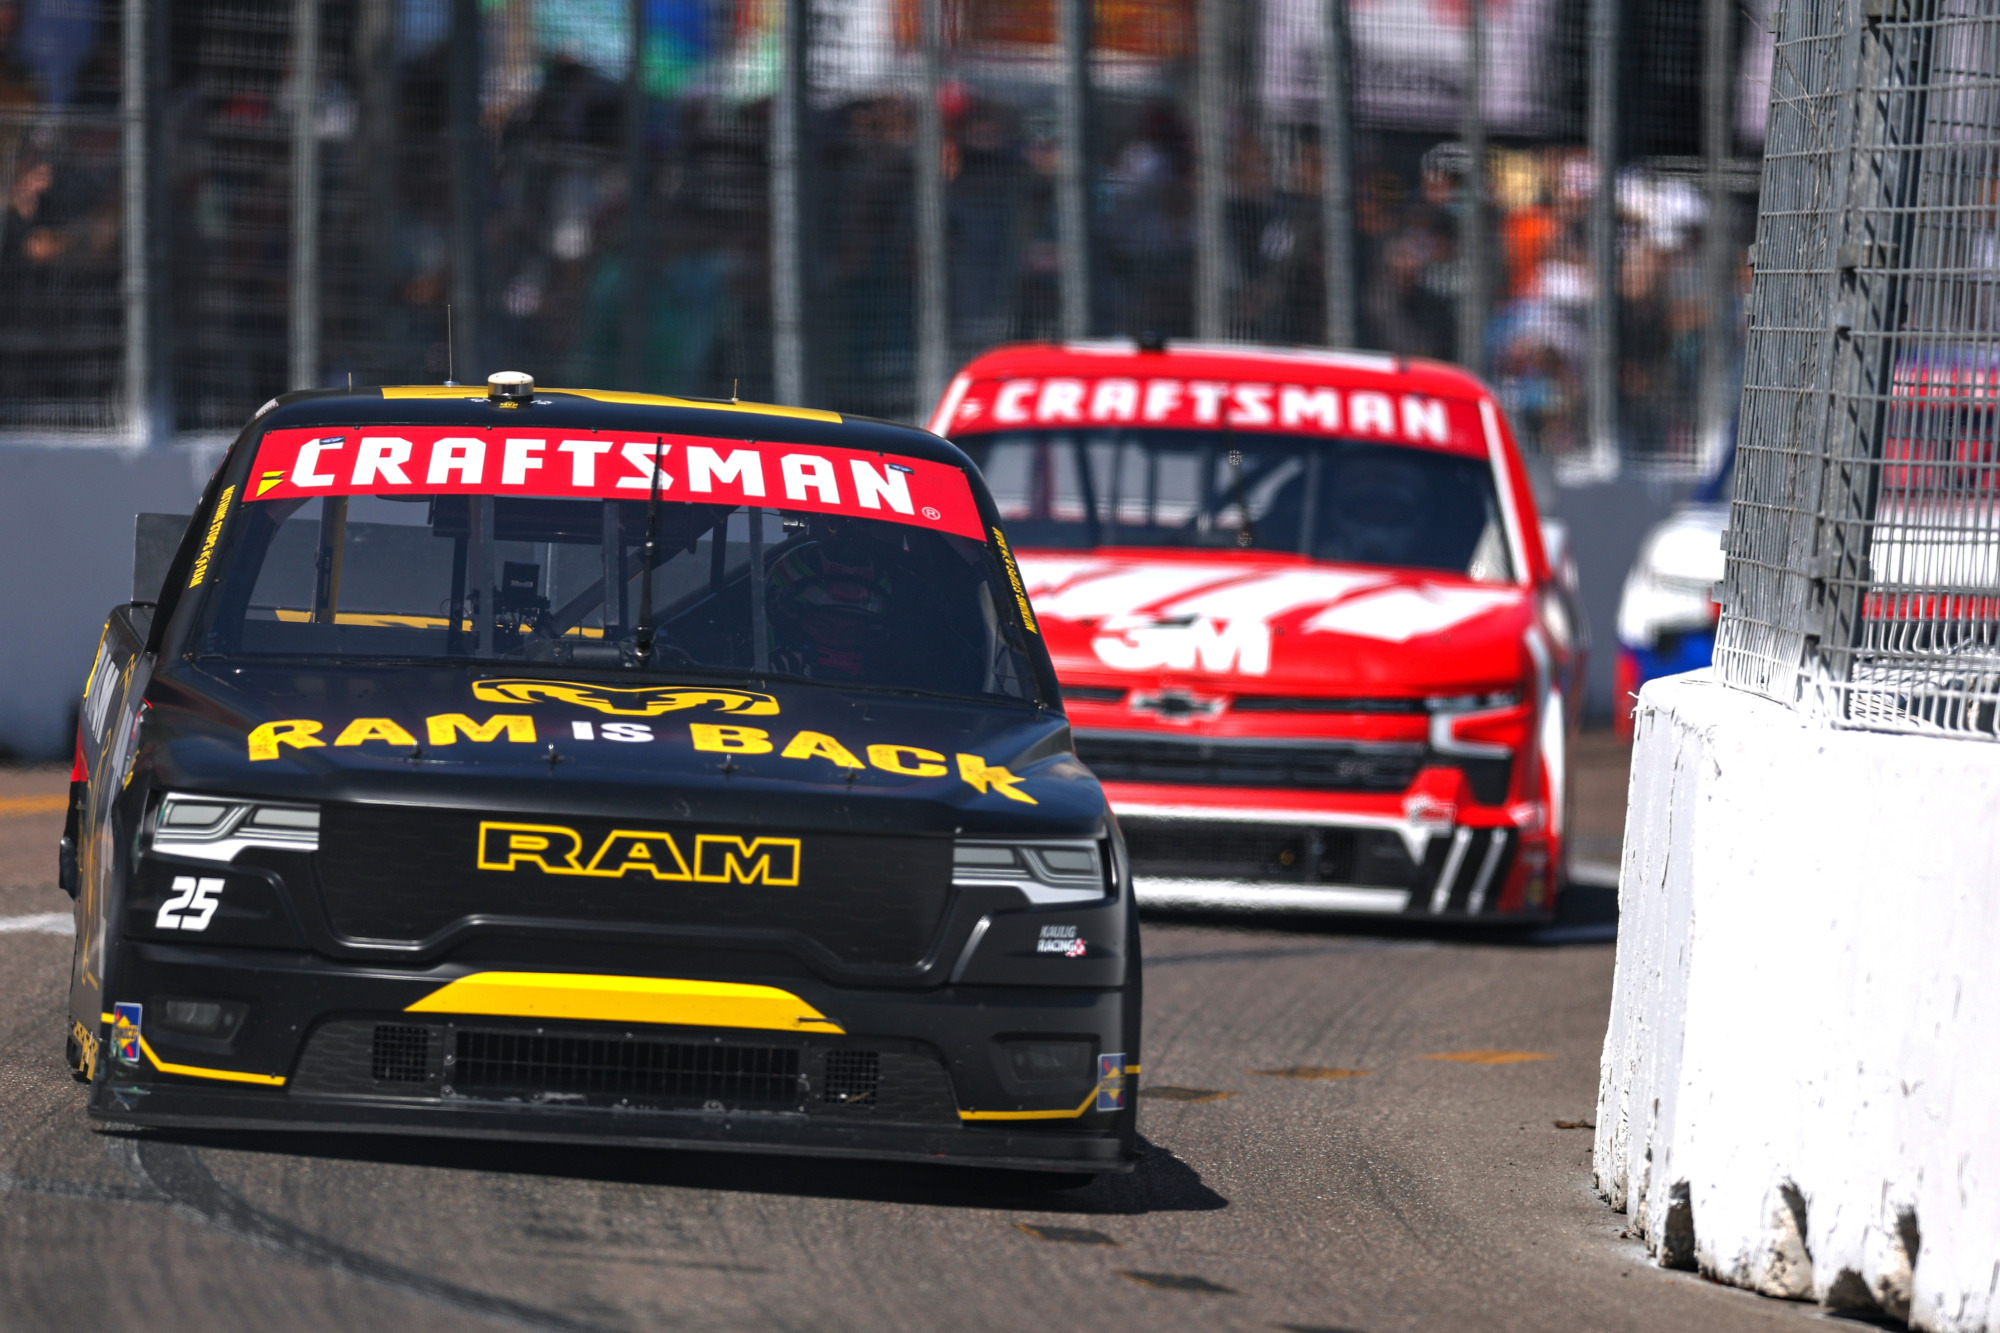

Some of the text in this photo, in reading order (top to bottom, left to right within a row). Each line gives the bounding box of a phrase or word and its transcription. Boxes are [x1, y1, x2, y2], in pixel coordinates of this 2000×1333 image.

[993, 378, 1448, 442] CRAFTSMAN
[290, 436, 915, 516] CRAFTSMAN
[1091, 615, 1271, 677] 3M
[247, 712, 1039, 805] RAM IS BACK
[476, 820, 802, 887] RAM
[155, 876, 225, 931] 25
[1036, 938, 1077, 953] RACING
